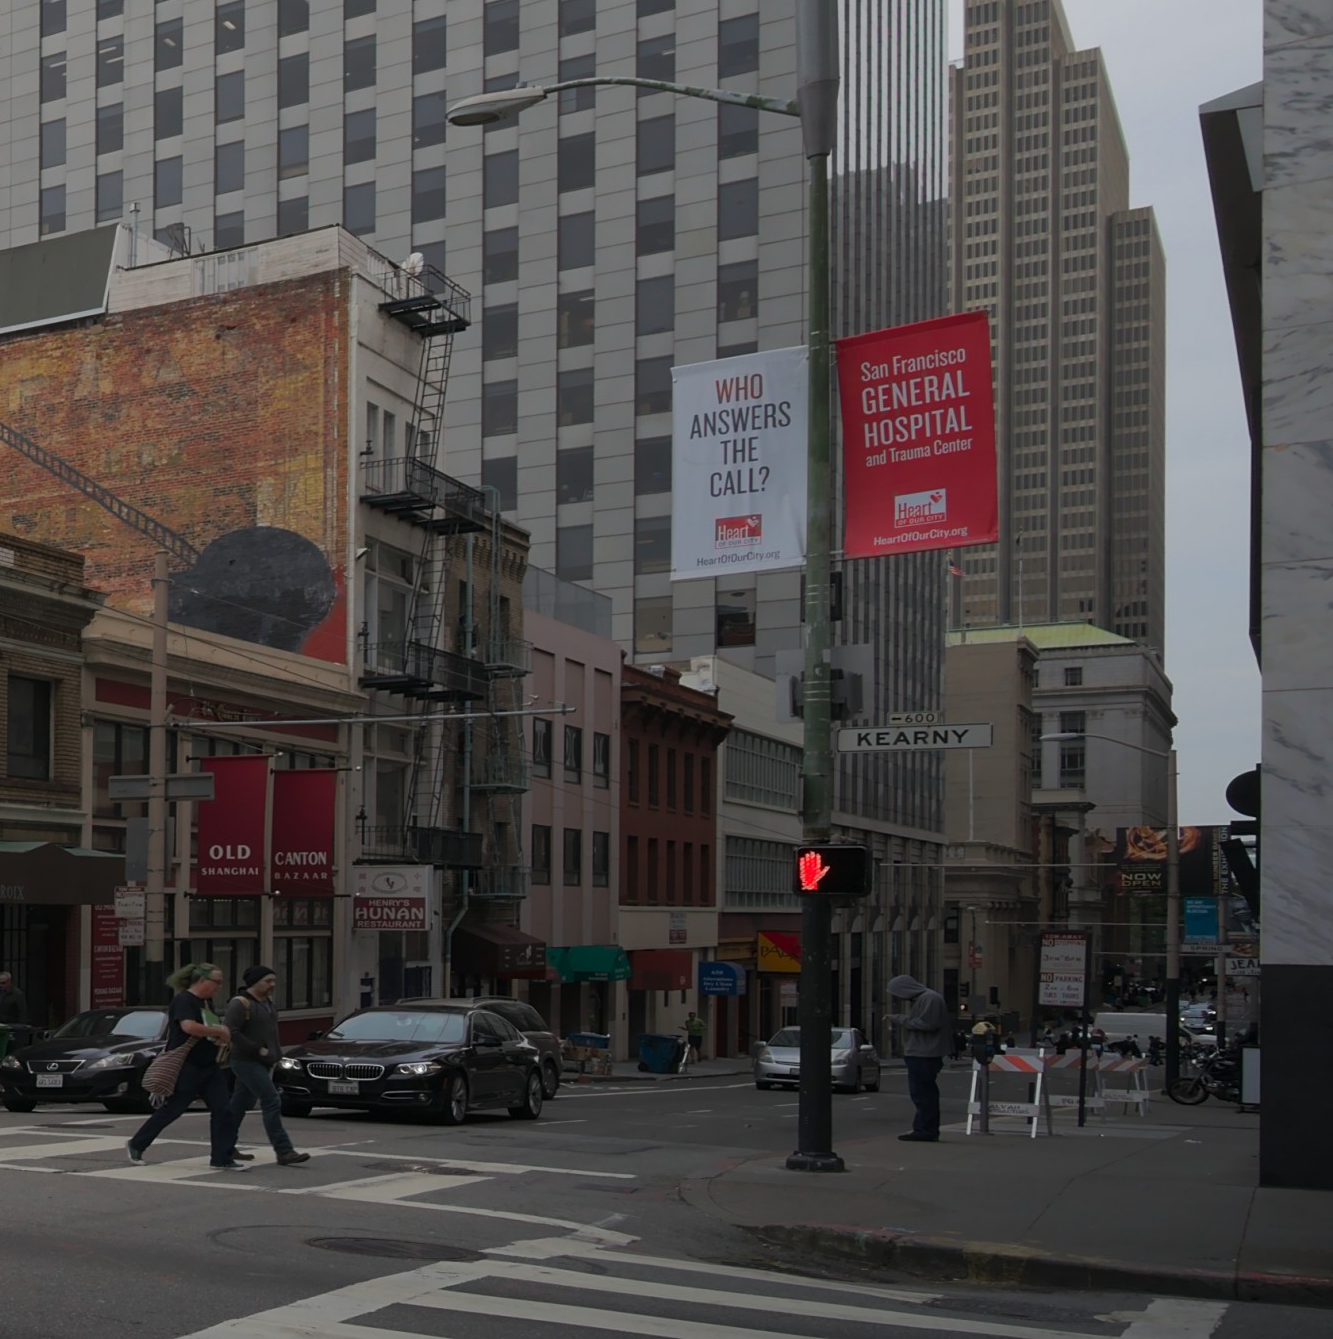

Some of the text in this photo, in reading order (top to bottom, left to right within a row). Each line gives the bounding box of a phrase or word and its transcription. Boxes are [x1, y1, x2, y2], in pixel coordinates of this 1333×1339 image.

[861, 348, 966, 382] San Francisco
[715, 373, 763, 404] WHO
[861, 370, 971, 415] GENERAL
[690, 401, 792, 439] ANSWERS
[864, 405, 973, 449] HOSPITAL
[720, 436, 759, 464] THE
[865, 437, 973, 468] and Trauma Center
[710, 466, 770, 497] CALL?
[898, 501, 932, 520] Heart
[897, 514, 944, 526] OF OUR CITY
[718, 524, 749, 541] Heart
[743, 537, 759, 545] CITY
[873, 526, 969, 547] HeartOfOurCity.org
[696, 550, 781, 567] HeartOfOurCity.org
[905, 714, 935, 723] 600
[857, 729, 969, 746] KEARNY
[208, 844, 252, 860] OLD
[274, 851, 327, 866] CANTON
[201, 867, 259, 876] SHANGHAI
[274, 872, 328, 880] BAZAAR
[1121, 873, 1162, 881] NOW
[368, 899, 410, 907] HENRY'S
[355, 907, 424, 920] HUNAN
[357, 920, 422, 928] RESTAURANT
[1041, 973, 1083, 983] NO PARKING
